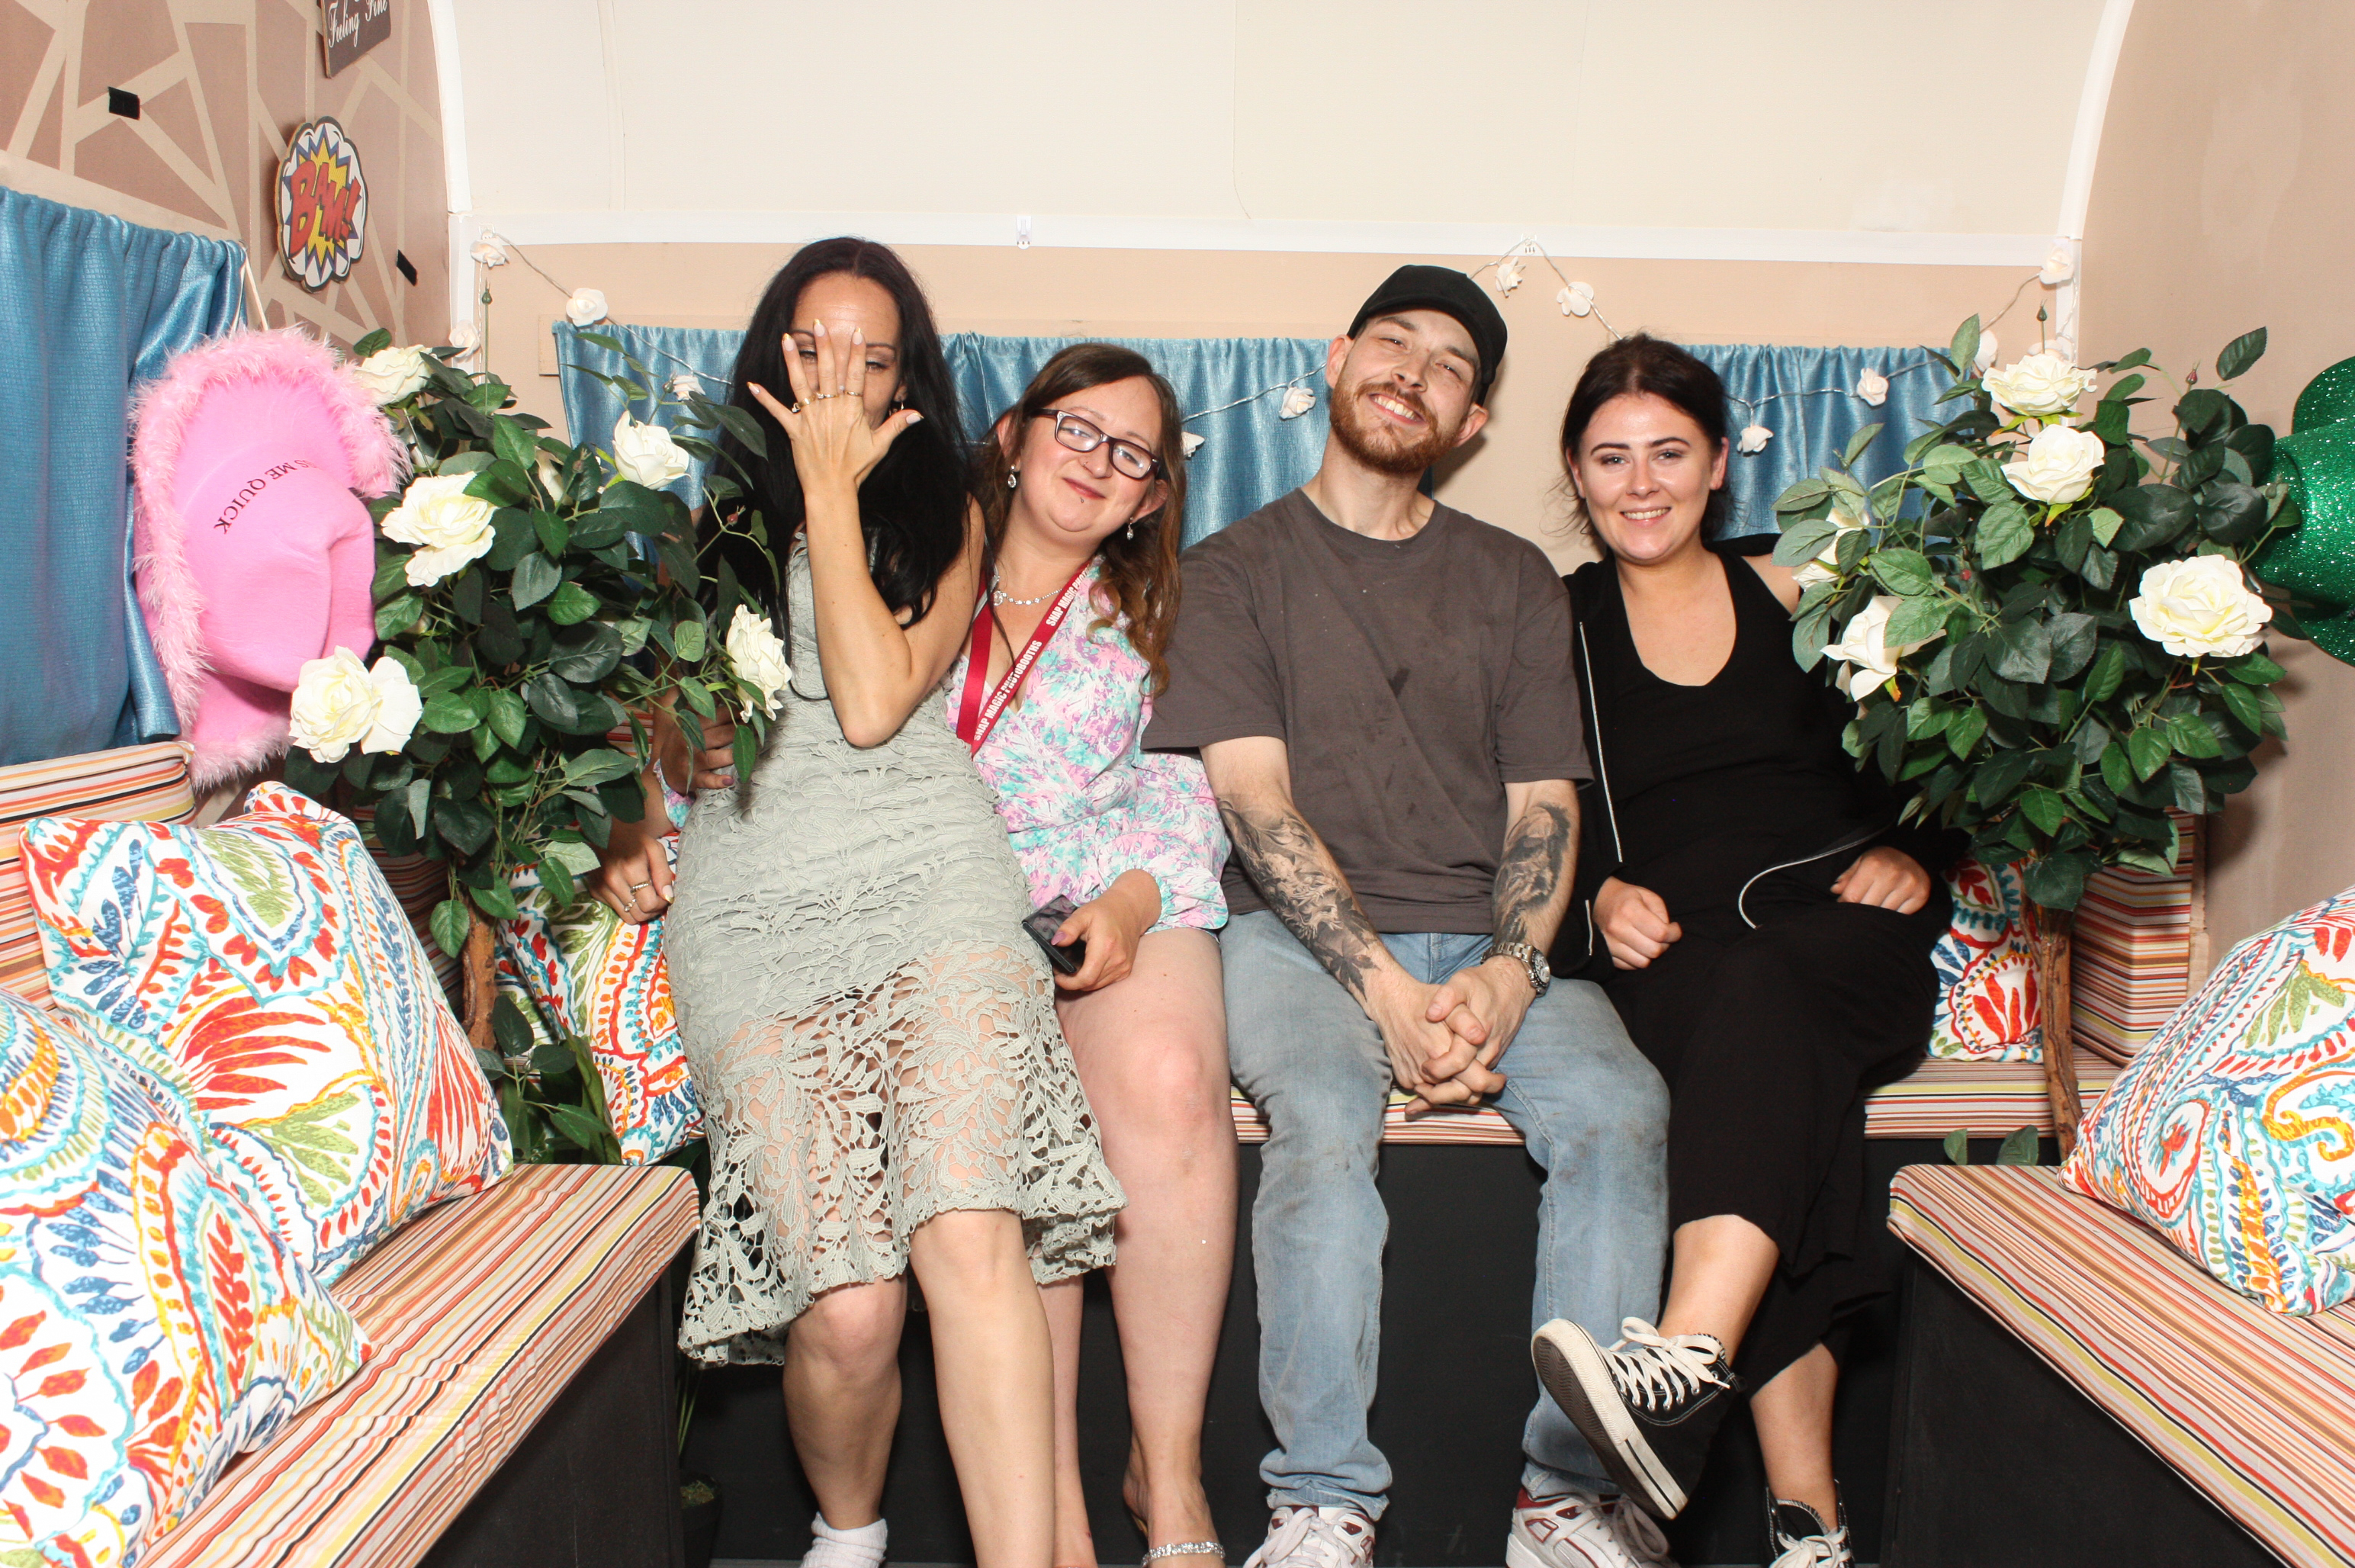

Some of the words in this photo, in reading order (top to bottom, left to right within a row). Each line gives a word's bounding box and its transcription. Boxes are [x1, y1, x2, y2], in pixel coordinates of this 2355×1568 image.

[328, 0, 359, 47] Feeling
[289, 160, 361, 256] BAM!
[264, 462, 297, 480] ME
[214, 478, 266, 535] QUICK
[1046, 606, 1064, 626] SNAP
[974, 718, 990, 741] SNAP
[1000, 640, 1043, 694] PHOTOBOOTHS
